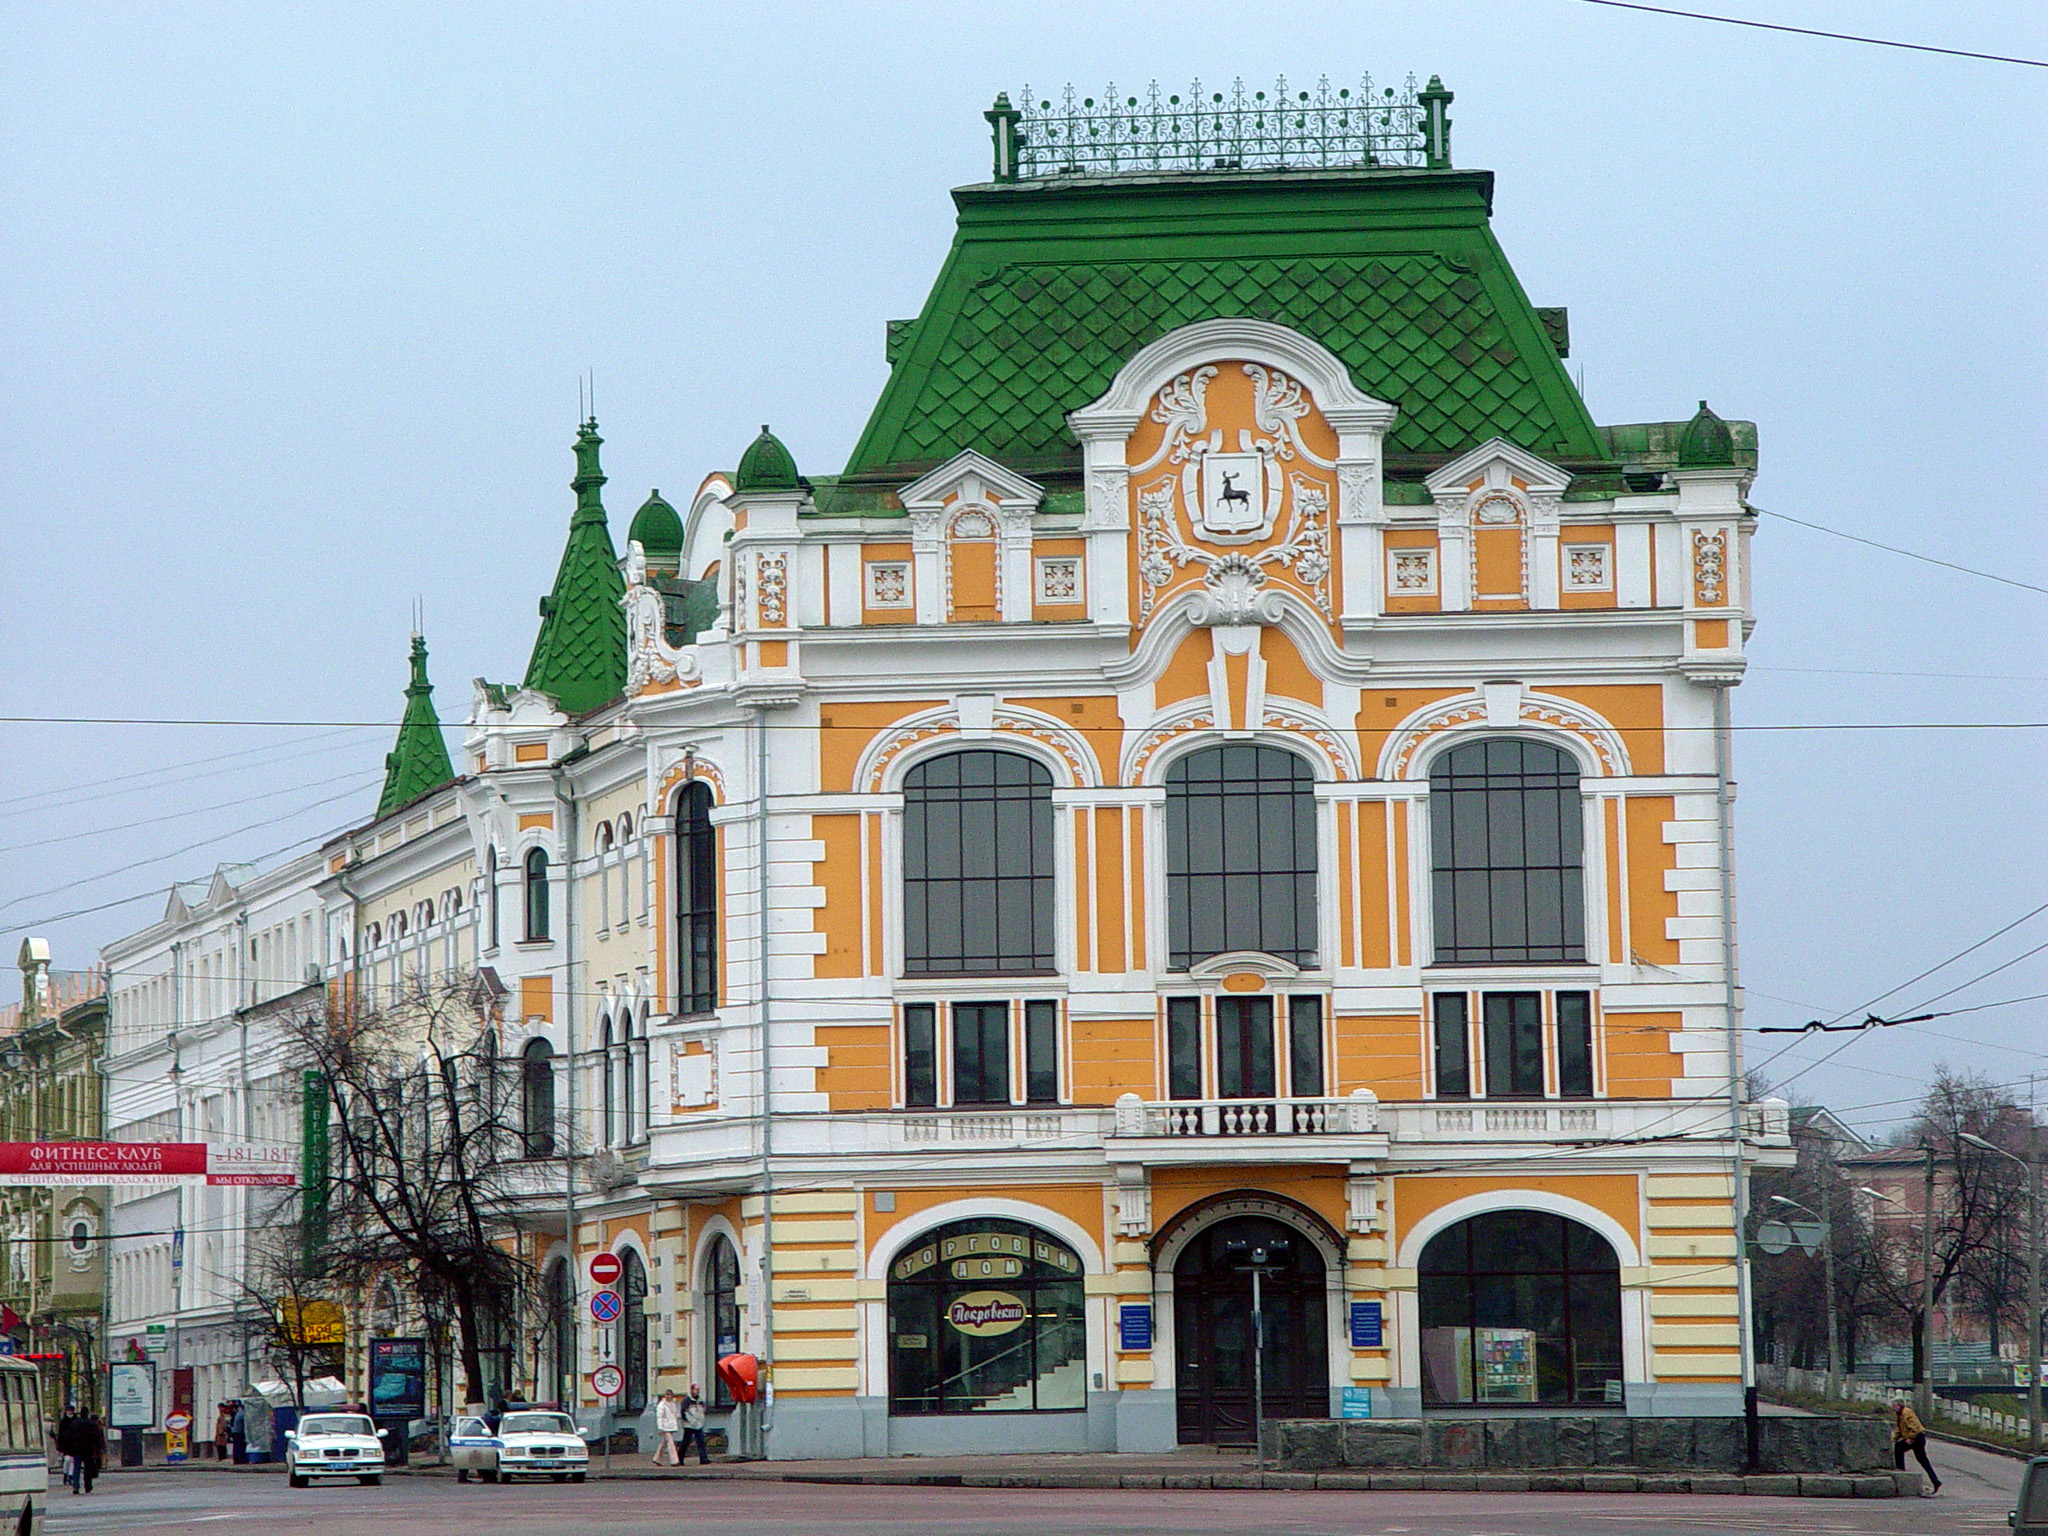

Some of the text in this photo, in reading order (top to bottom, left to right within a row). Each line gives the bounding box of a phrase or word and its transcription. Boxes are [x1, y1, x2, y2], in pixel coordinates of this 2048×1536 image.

[29, 1146, 162, 1161] ФИТНЕС-КЛУБ
[227, 1147, 289, 1161] 181-181
[28, 1161, 162, 1171] ДЛЯ УСПЕШНЫХ ЛЮДЕЙ
[10, 1174, 182, 1185] СПЕЦИАЛЬНОЕ ПРЕДЛОЖЕНИЕ
[957, 1259, 1017, 1278] ДОМ
[953, 1300, 1023, 1325] Покровский
